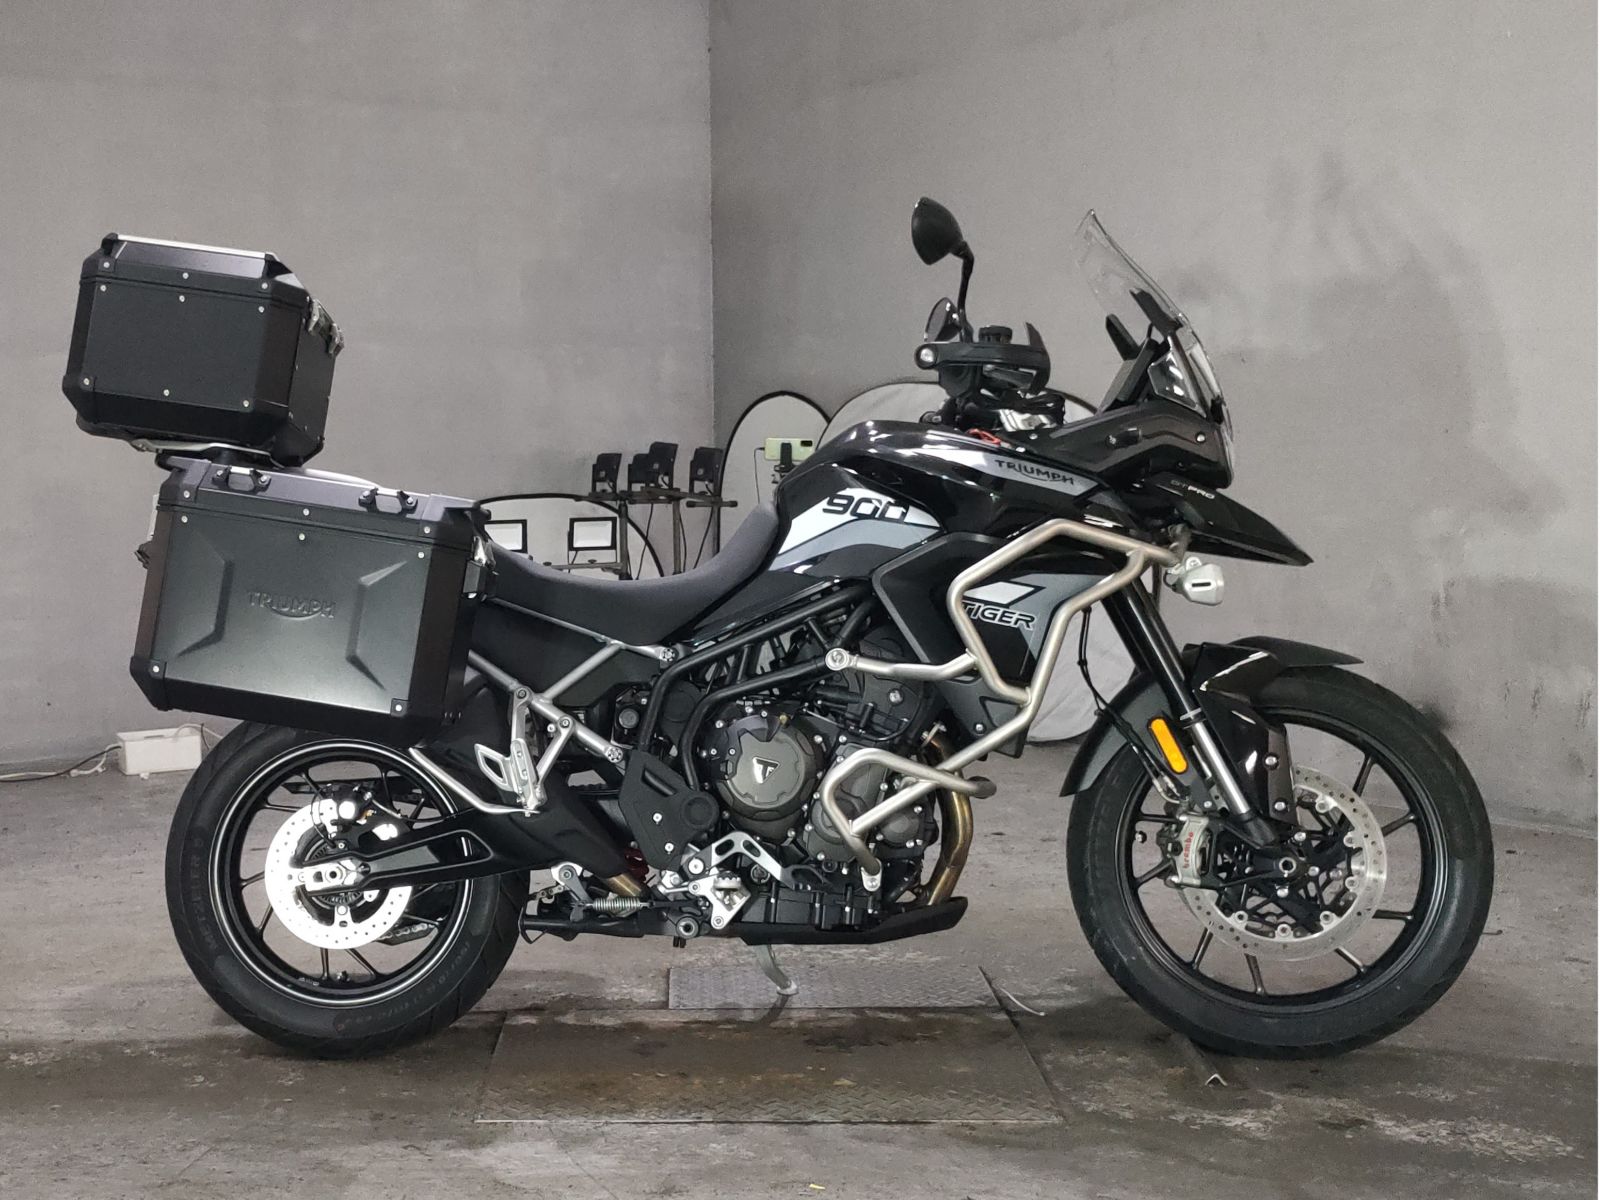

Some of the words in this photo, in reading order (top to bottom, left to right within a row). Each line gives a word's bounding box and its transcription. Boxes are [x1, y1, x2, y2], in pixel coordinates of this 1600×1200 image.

[994, 459, 1074, 485] TRIUMPH
[822, 494, 910, 524] 900
[247, 591, 337, 620] TRIUMPH
[962, 600, 1037, 631] TIGER
[1182, 831, 1195, 869] brembo
